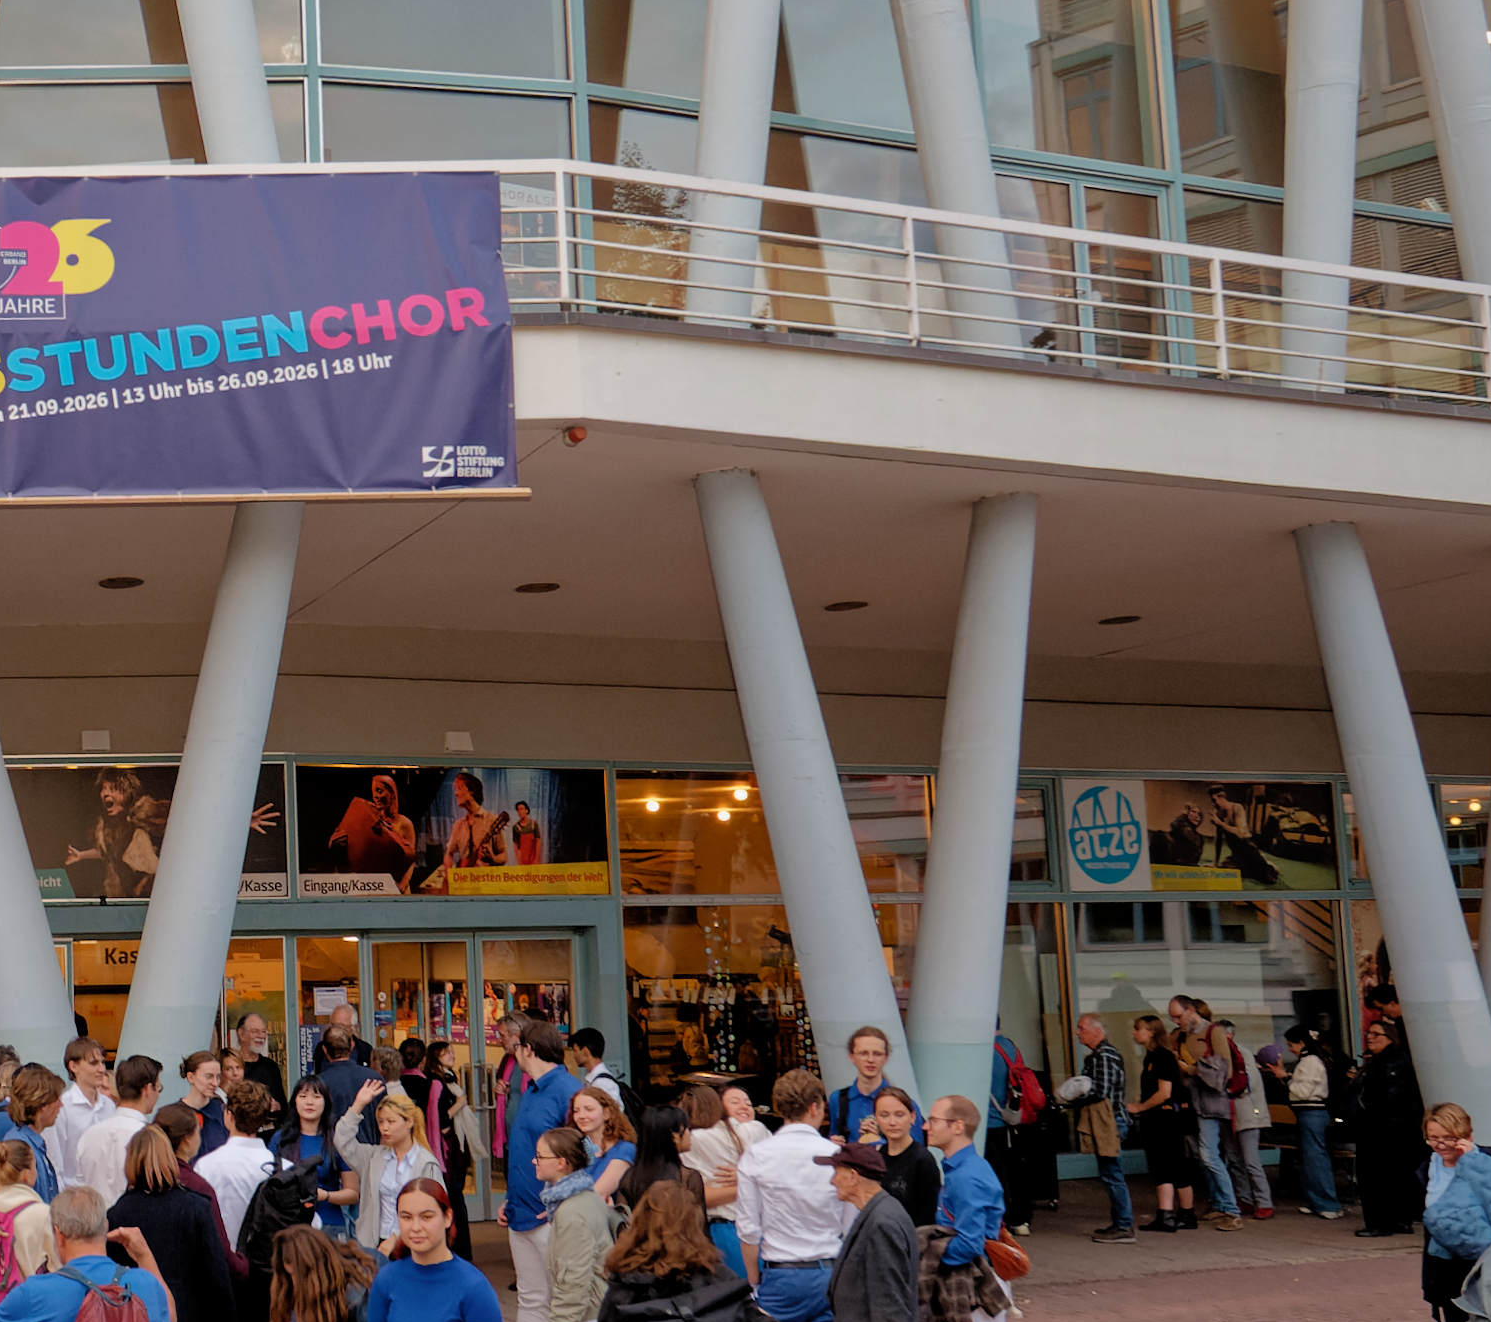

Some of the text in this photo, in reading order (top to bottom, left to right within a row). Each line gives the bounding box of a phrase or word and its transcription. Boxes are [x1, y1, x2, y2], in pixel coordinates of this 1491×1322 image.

[8, 392, 109, 422] 21.09.2026
[123, 387, 145, 404] 13
[149, 382, 184, 402] Uhr
[187, 376, 214, 397] bis
[218, 364, 319, 392] 26.09.2026
[333, 358, 355, 375] 18
[359, 351, 393, 373] Uhr
[457, 446, 487, 456] LOTTO
[457, 456, 505, 467] STIFTUNG
[457, 467, 493, 477] BERLIN
[1074, 824, 1140, 860] atze
[38, 876, 62, 887] icht
[453, 871, 604, 885] Die besten Beerdigungen der Welt
[304, 880, 384, 895] Eingang/Kasse
